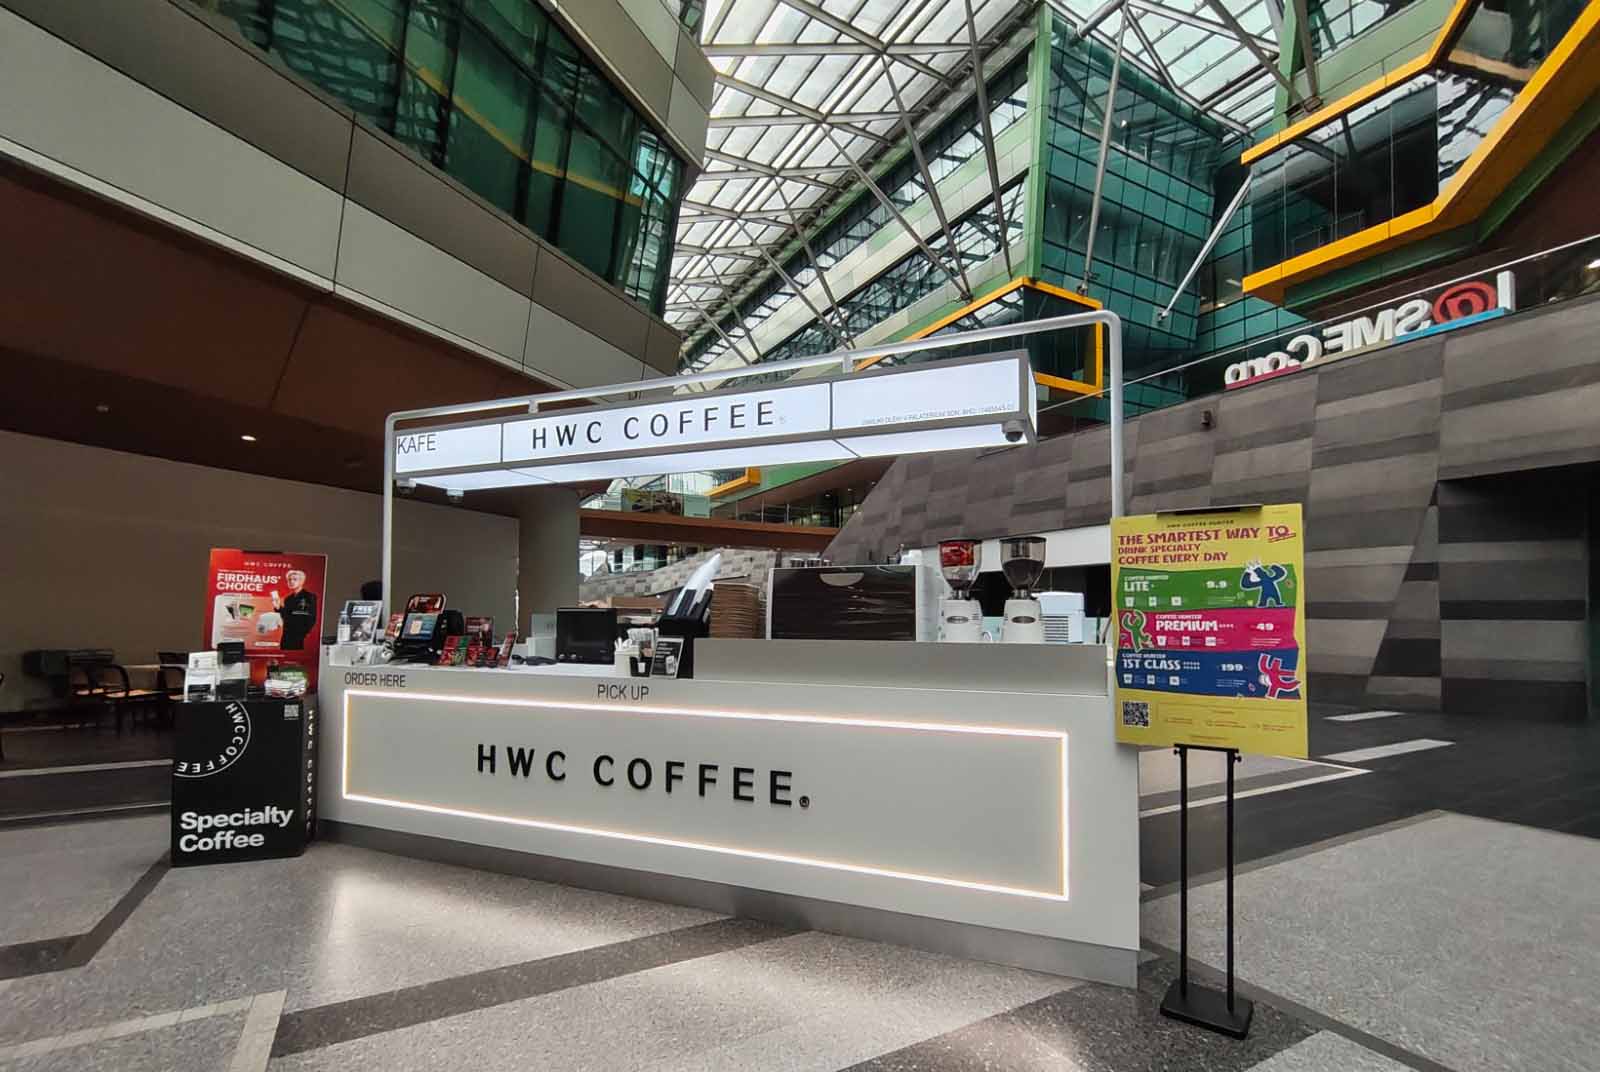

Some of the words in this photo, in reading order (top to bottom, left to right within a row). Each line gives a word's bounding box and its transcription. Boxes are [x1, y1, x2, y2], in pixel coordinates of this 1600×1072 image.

[532, 421, 602, 449] HWC
[624, 401, 773, 440] COFFEE
[397, 434, 437, 454] KAFE
[1119, 535, 1143, 545] THE
[1147, 529, 1221, 544] SMARTEST
[1226, 527, 1260, 539] WAY
[1266, 526, 1289, 537] TO
[1118, 546, 1146, 555] DRINK
[1150, 543, 1201, 553] SPECIALTY
[1118, 555, 1160, 565] COFFEE
[1163, 553, 1200, 563] EVERY
[1204, 551, 1229, 561] DAY
[216, 581, 263, 592] CHOICE
[1124, 581, 1149, 592] LITE
[1156, 620, 1218, 631] PREMIUM
[1256, 622, 1275, 631] 49
[1122, 659, 1140, 669] 1ST
[1144, 659, 1181, 670] CLASS
[1221, 663, 1244, 672] 199
[345, 672, 377, 685] ORDER
[379, 674, 406, 688] HERE
[597, 684, 627, 699] PICK
[631, 685, 650, 701] UP
[477, 743, 566, 781] HWC
[593, 754, 793, 807] COFFEE
[180, 806, 294, 832] Specialty
[179, 830, 265, 852] Coffee
